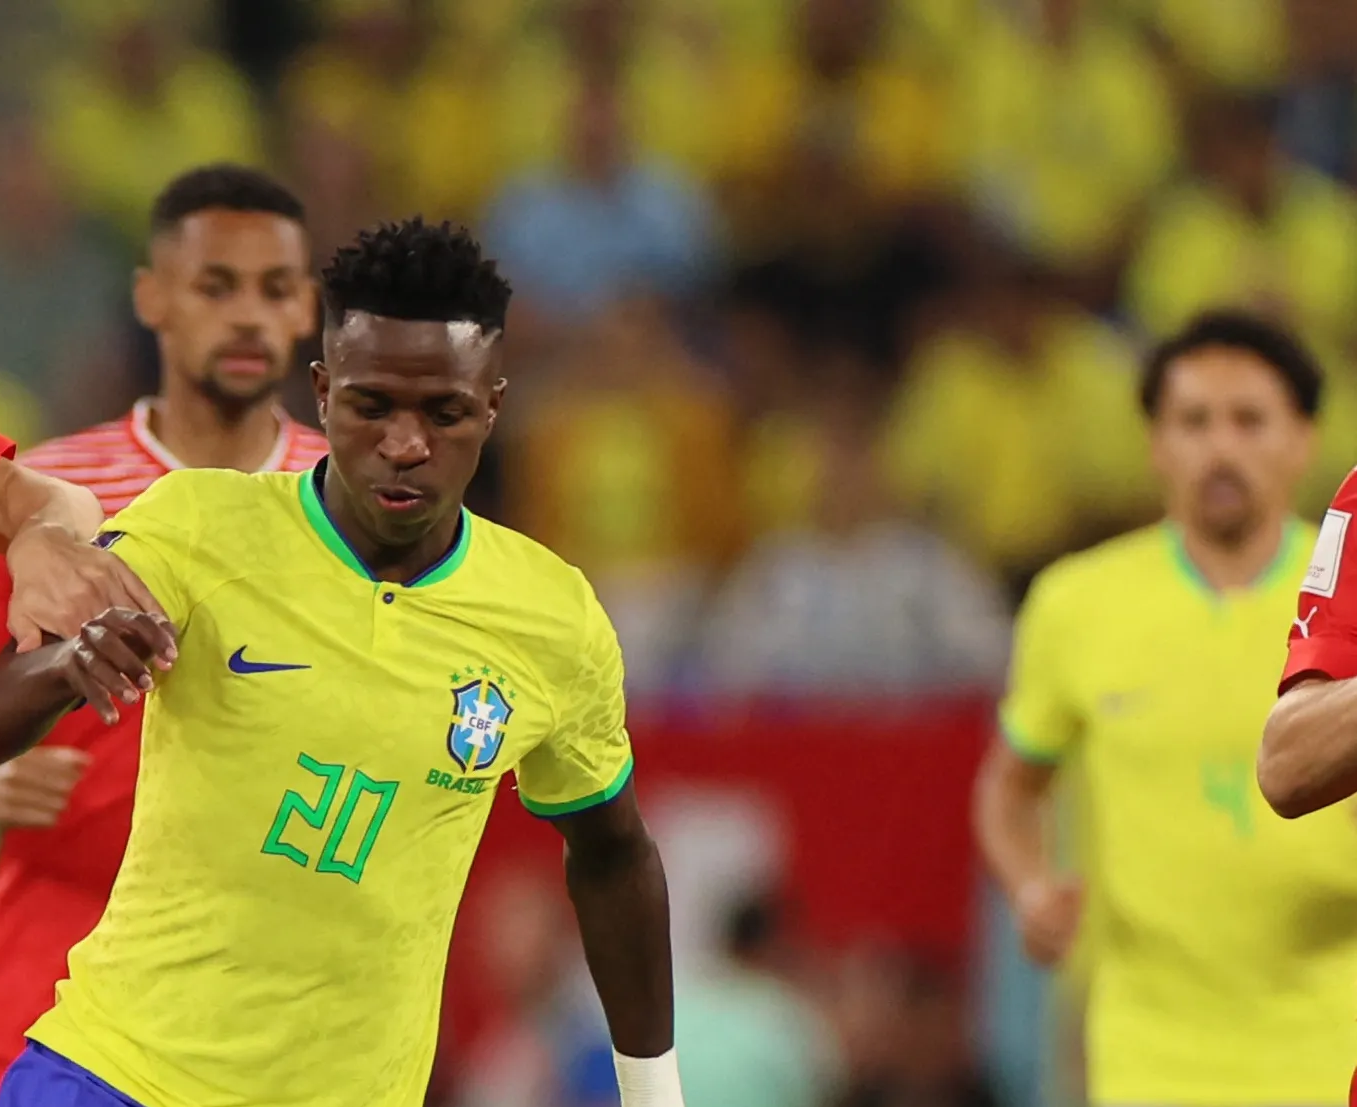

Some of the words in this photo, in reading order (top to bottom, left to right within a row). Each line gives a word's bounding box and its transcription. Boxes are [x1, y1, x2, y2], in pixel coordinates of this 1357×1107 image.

[468, 716, 492, 731] CBF
[425, 768, 489, 795] BRASIL
[260, 751, 401, 885] 20
